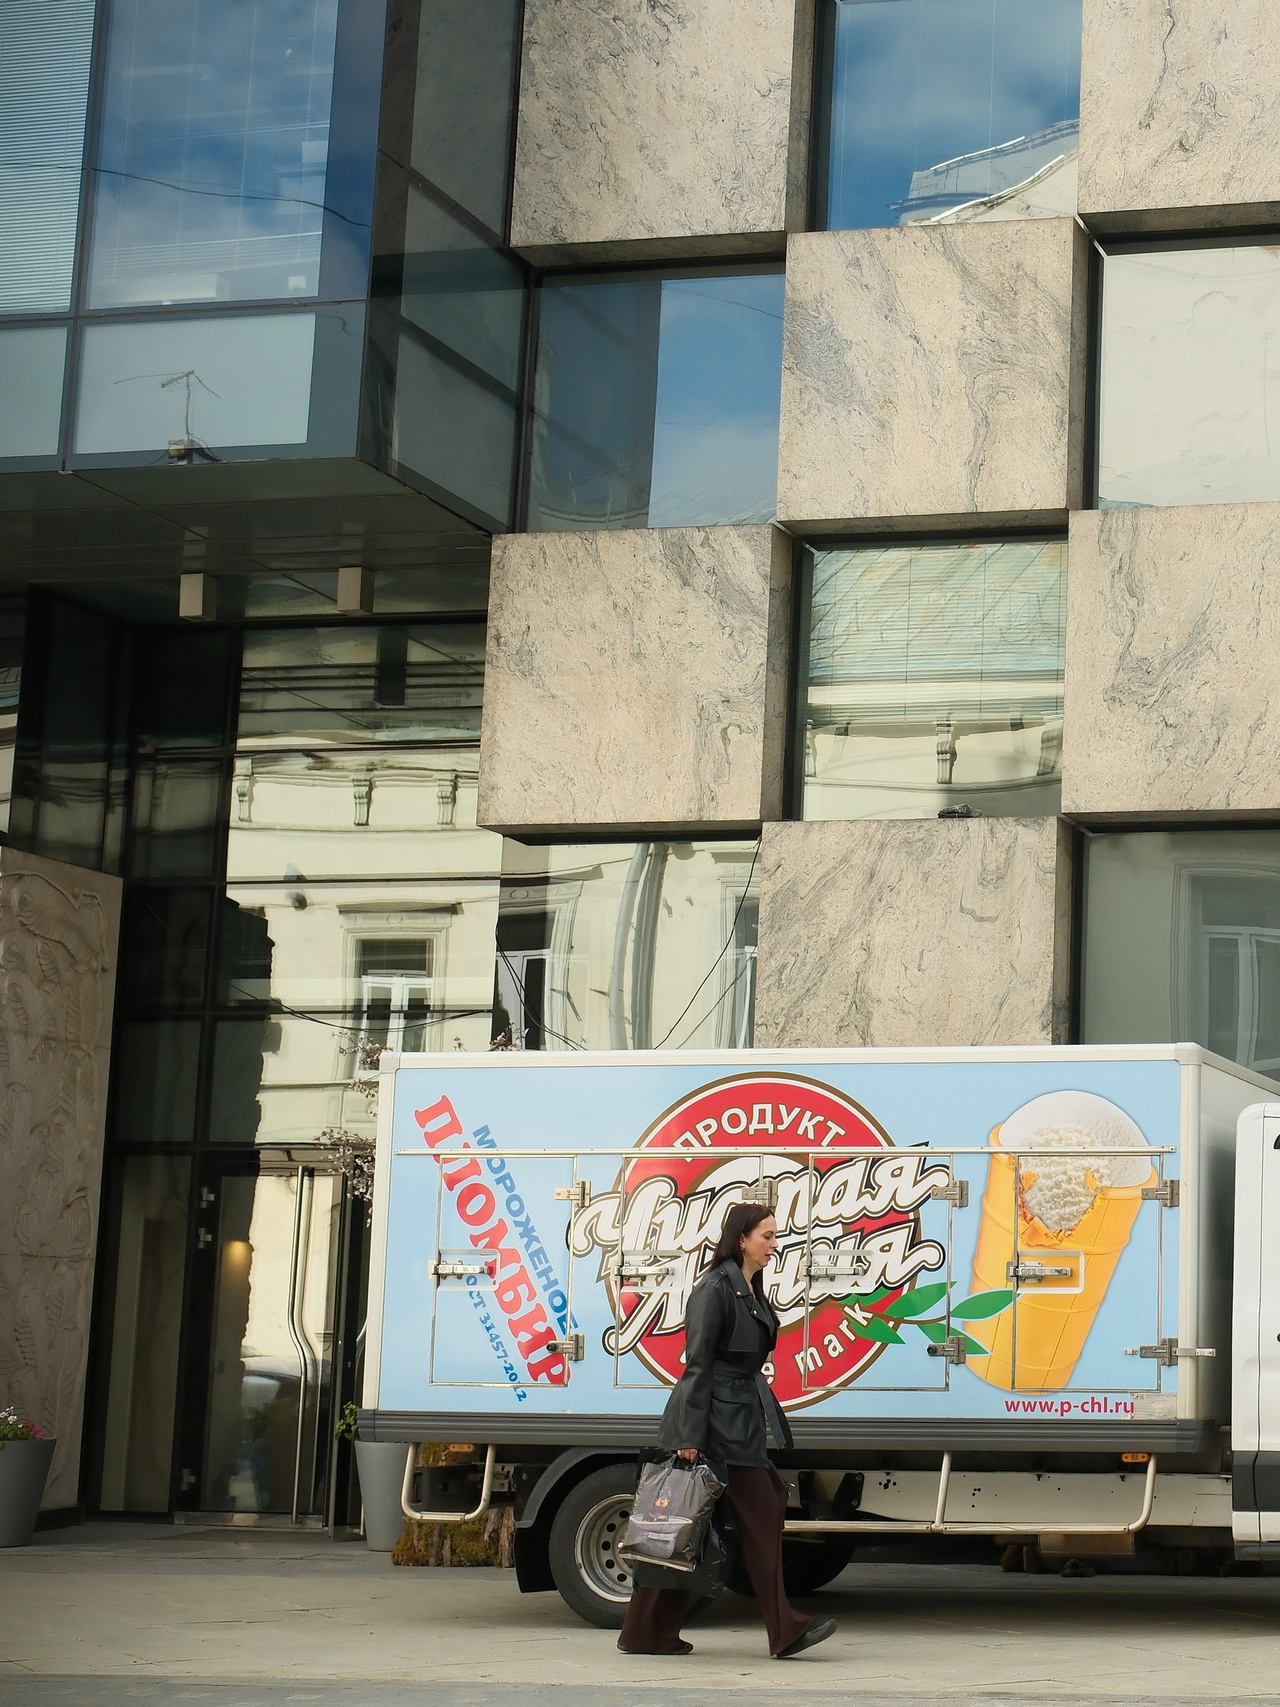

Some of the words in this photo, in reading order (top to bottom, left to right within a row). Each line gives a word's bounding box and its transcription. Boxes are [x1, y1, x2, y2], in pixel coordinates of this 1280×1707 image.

[673, 1103, 847, 1163] ПРОДУКТ
[414, 1094, 571, 1385] ПЛОМБИР
[473, 1124, 579, 1336] МОРОЖЕНОЕ
[794, 1302, 874, 1376] mark
[1004, 1396, 1135, 1417] www.p-chl.ru
